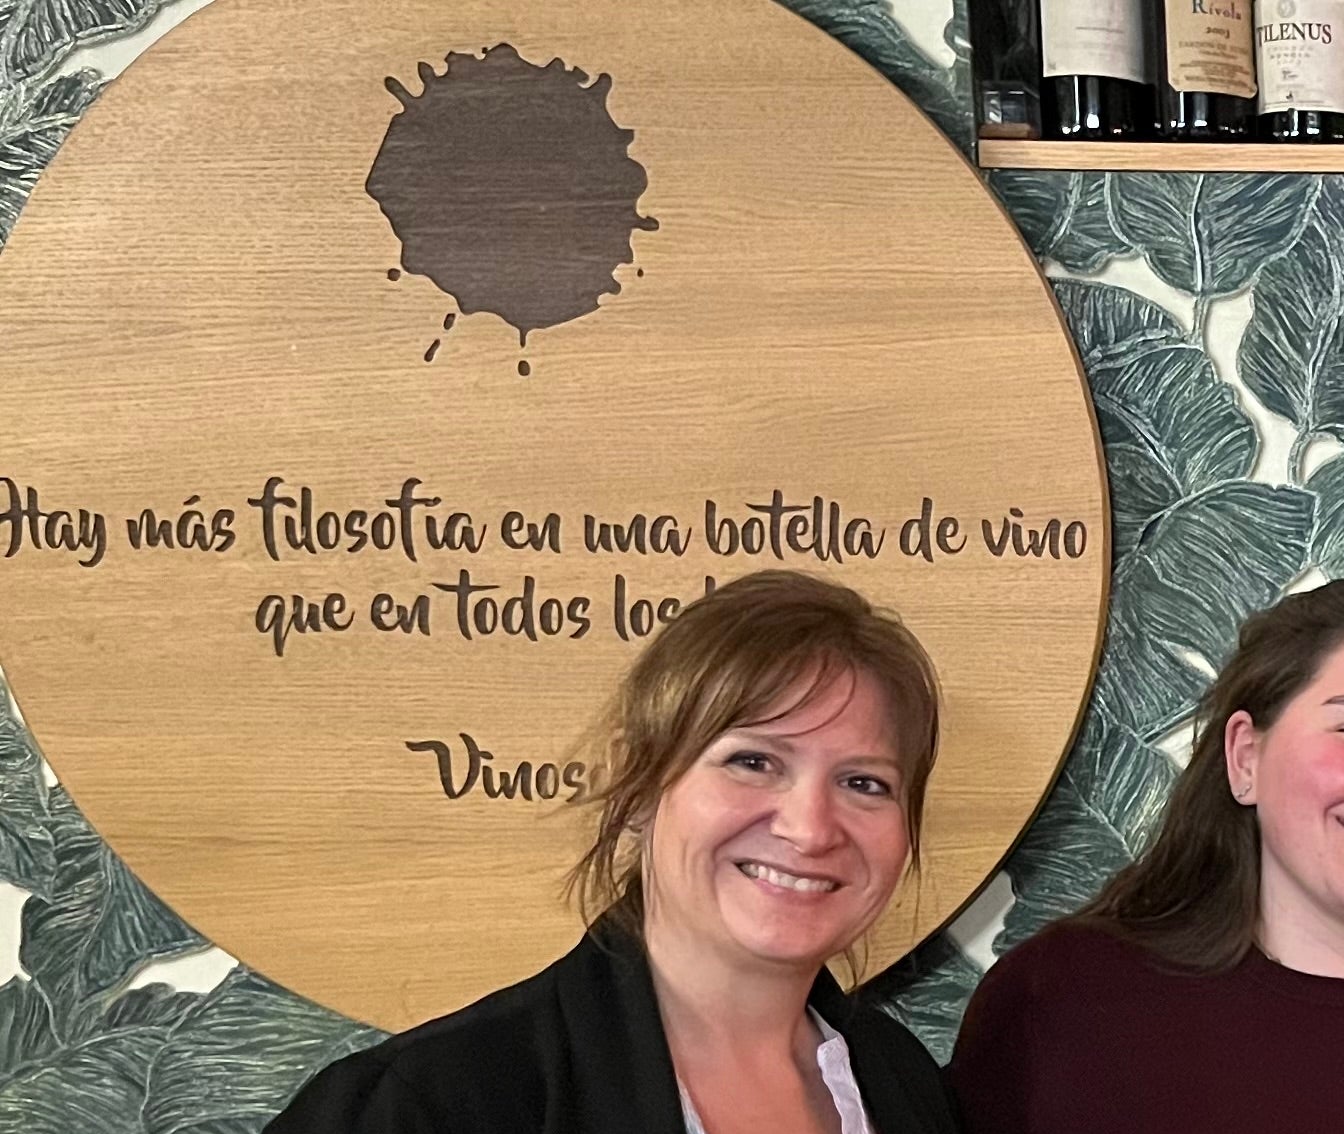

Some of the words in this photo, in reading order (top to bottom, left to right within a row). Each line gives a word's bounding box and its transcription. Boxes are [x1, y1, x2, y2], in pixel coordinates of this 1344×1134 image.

[1257, 22, 1332, 47] TILENUS
[0, 477, 107, 567] Hay
[126, 495, 237, 552] más
[501, 509, 561, 554] en
[583, 513, 693, 557] una
[705, 489, 887, 563] botella
[899, 497, 968, 562] de
[981, 507, 1086, 560] vino
[255, 592, 356, 657] que
[370, 592, 431, 637] en
[430, 568, 591, 641] todos
[405, 732, 587, 803] Vinos
